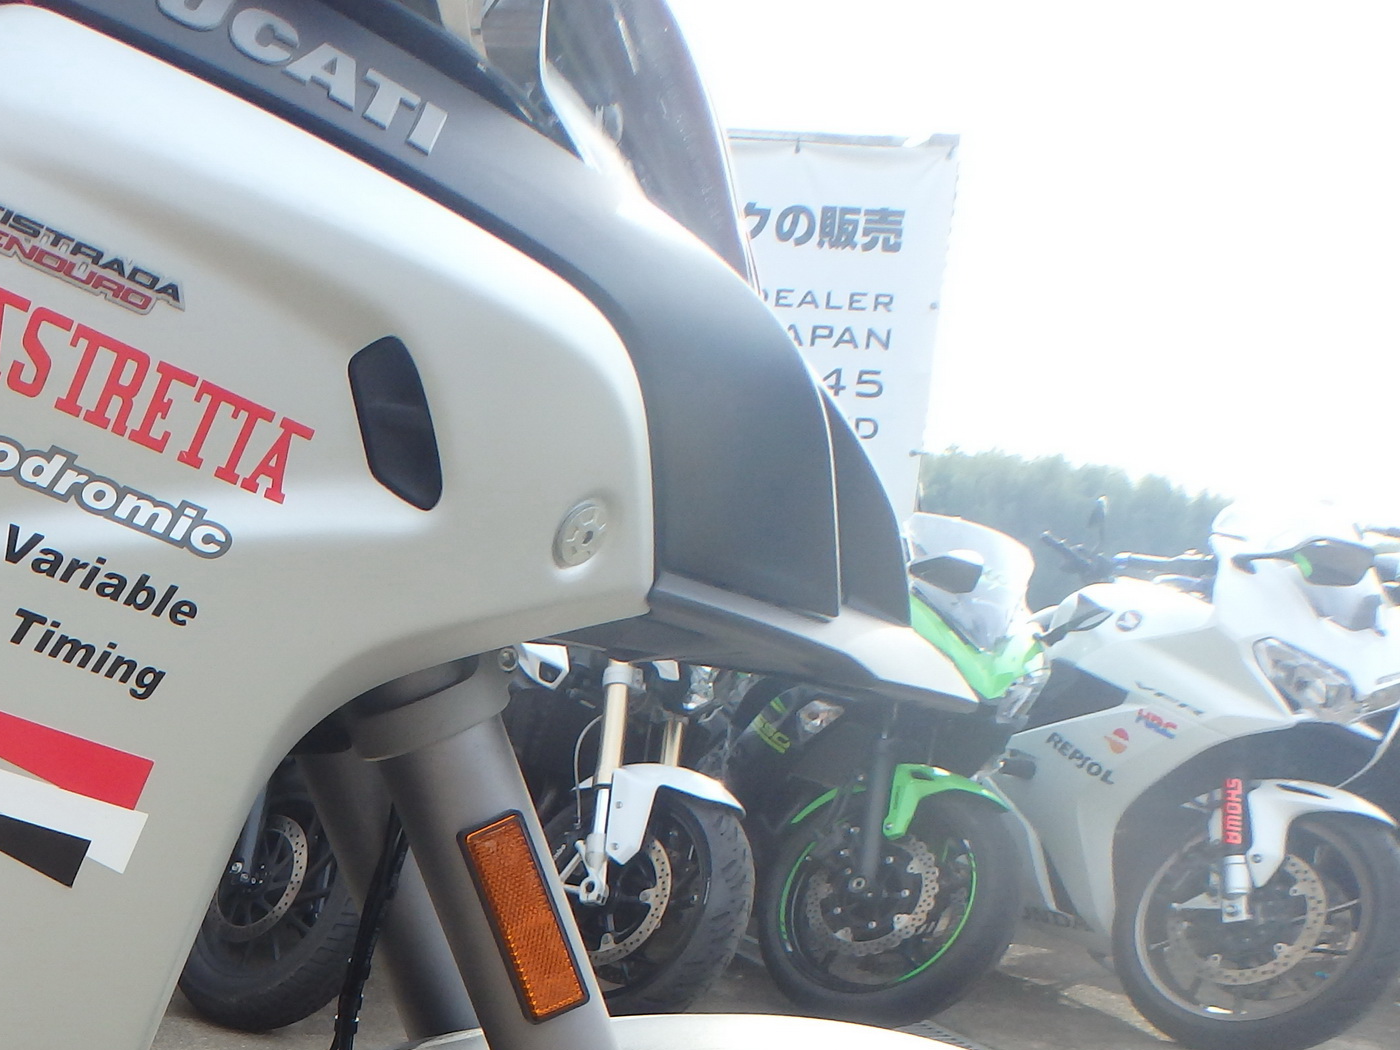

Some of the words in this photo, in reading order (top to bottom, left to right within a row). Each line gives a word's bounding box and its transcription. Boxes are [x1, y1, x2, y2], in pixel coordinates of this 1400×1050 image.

[4, 523, 198, 627] Variable
[9, 607, 167, 700] Timing
[1045, 731, 1115, 786] REPSOL
[1224, 777, 1243, 845] SHOWA
